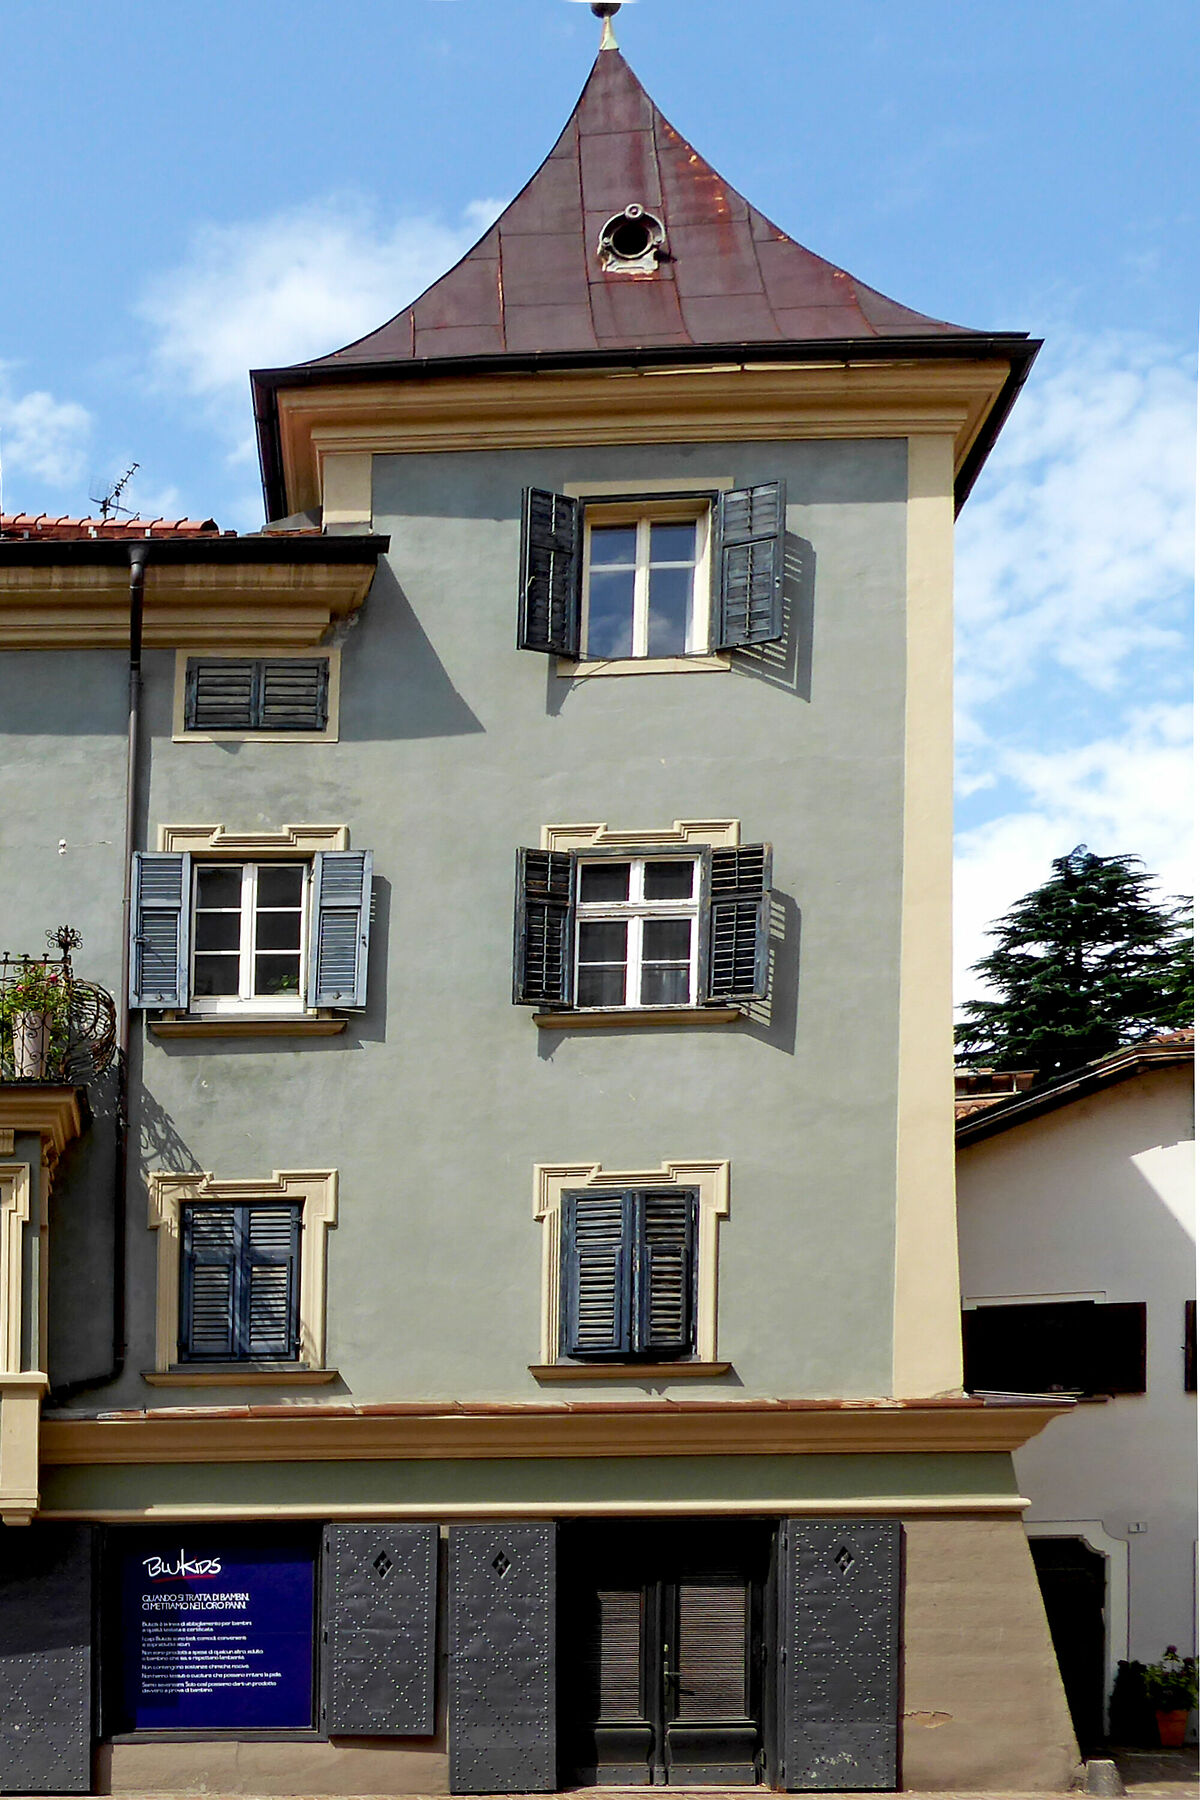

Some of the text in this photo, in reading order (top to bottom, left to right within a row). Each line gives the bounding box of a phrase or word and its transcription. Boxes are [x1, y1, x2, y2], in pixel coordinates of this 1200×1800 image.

[142, 1594, 177, 1602] QUANDO
[185, 1593, 211, 1601] TRATTA
[150, 1602, 189, 1610] METTIAMO
[201, 1601, 224, 1610] LORO
